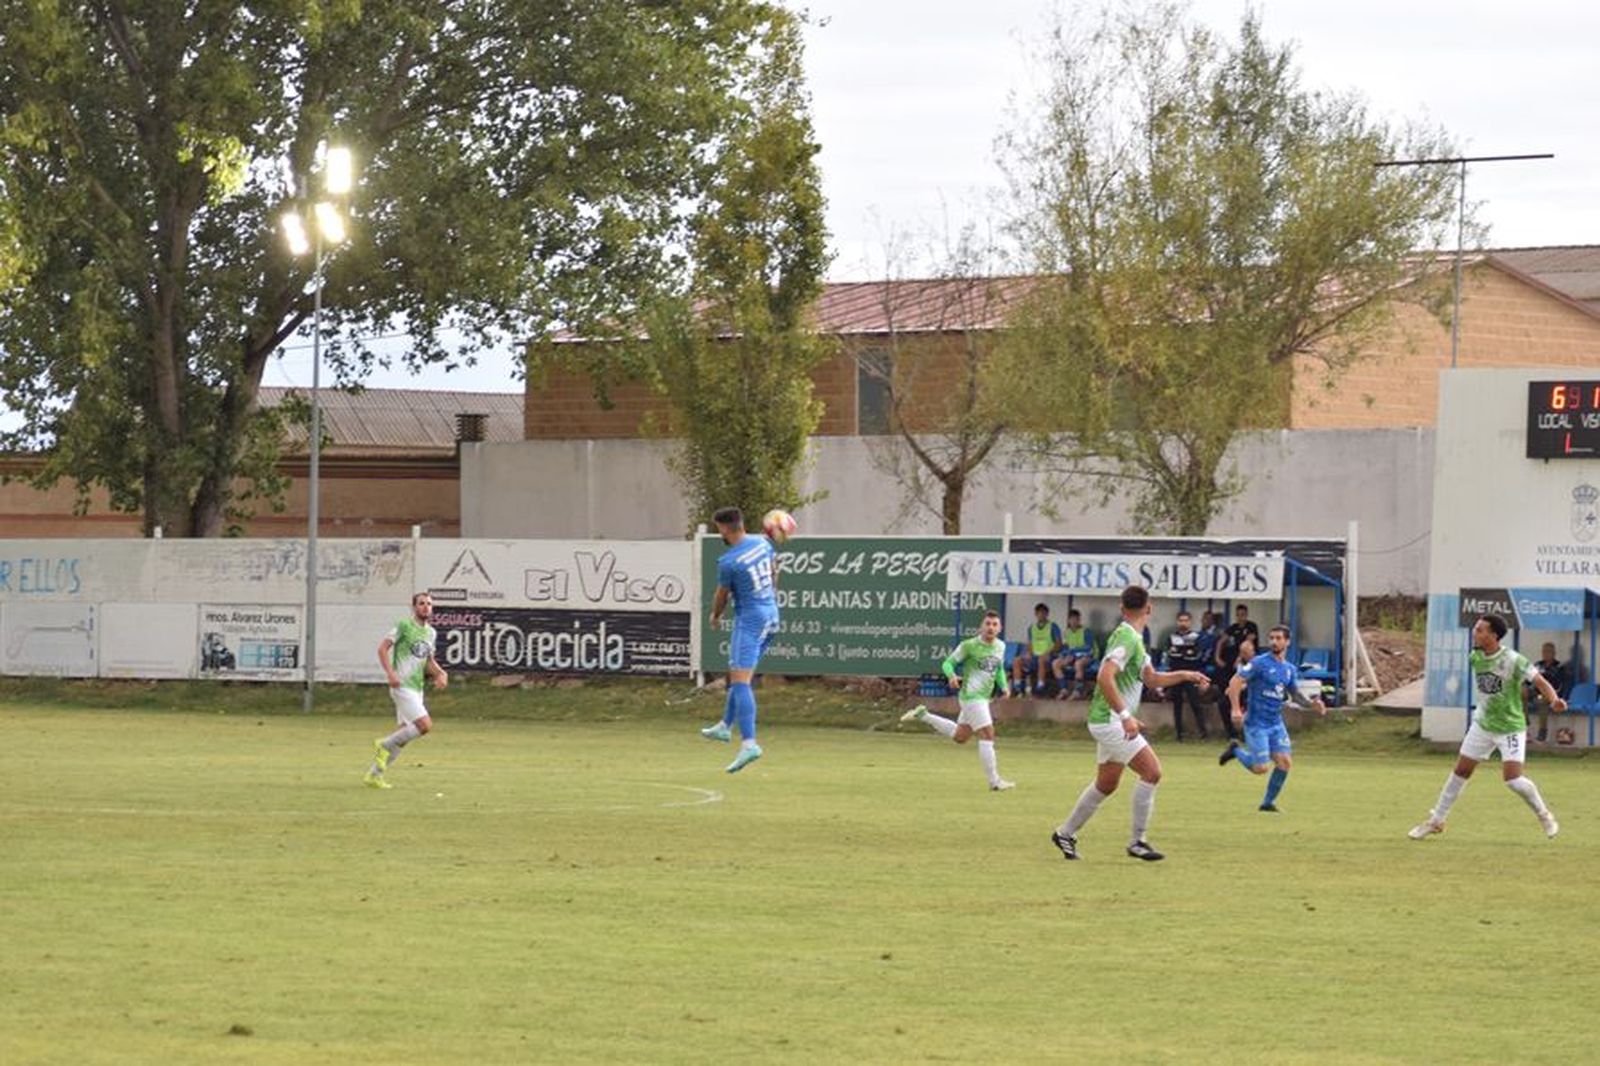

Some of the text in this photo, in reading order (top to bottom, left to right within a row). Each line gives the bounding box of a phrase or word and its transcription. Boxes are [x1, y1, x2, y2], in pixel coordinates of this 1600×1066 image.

[1538, 413, 1573, 429] LOCAL
[524, 551, 685, 602] El Viso
[829, 551, 866, 575] LA
[871, 552, 951, 581] PERGO
[979, 559, 1268, 592] TALLERES SALUDES
[777, 590, 797, 608] DE
[802, 591, 871, 609] PLANTAS
[876, 591, 887, 609] Y
